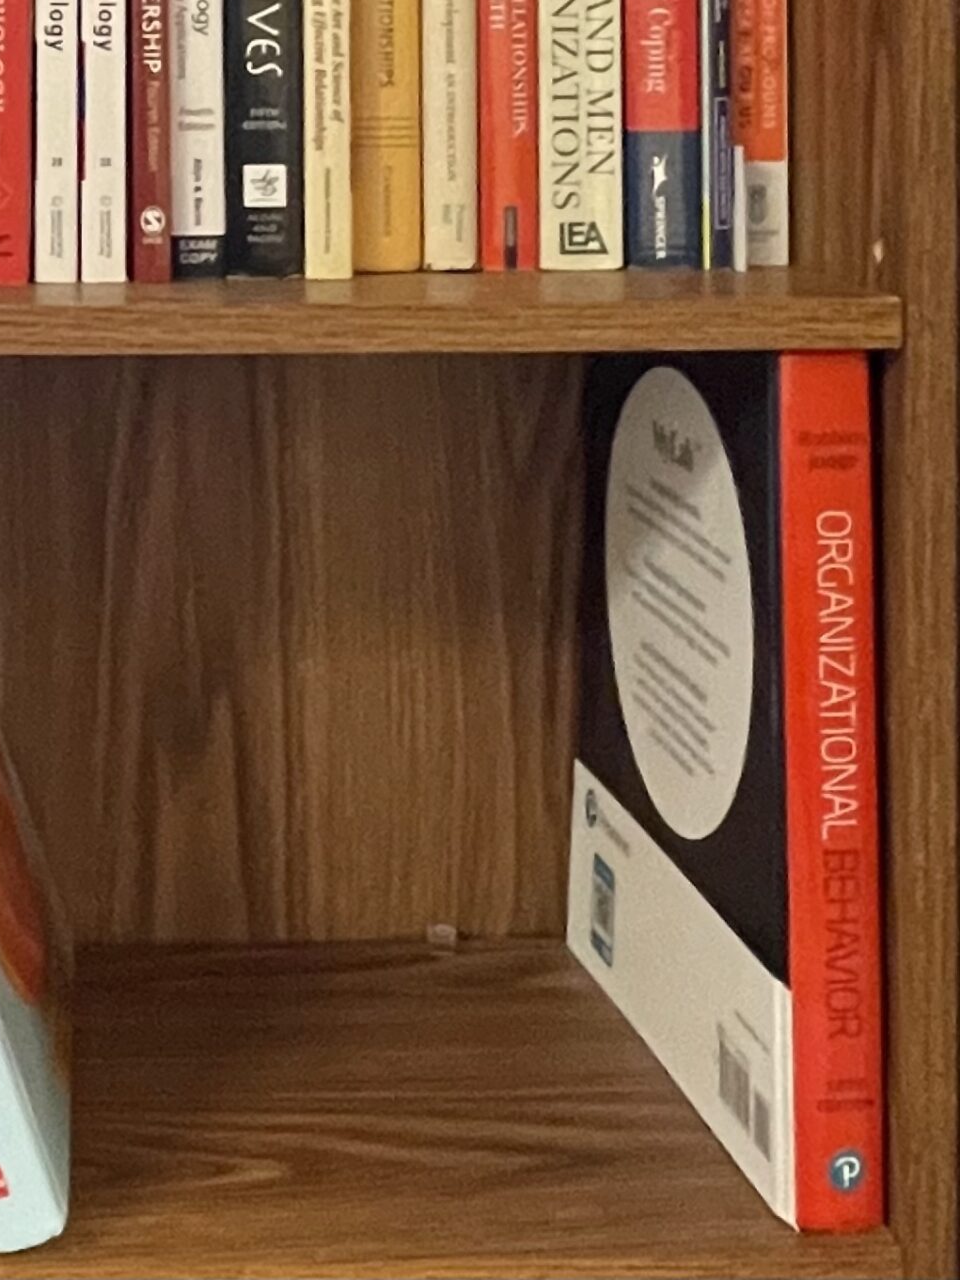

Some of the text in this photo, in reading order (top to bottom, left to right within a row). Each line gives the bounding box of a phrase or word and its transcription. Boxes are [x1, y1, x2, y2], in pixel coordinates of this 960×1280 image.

[175, 5, 189, 79] Applications
[585, 89, 615, 176] MEN
[179, 252, 219, 265] COPY
[654, 195, 667, 260] SPRINGER
[815, 510, 861, 839] ORGANIZATIONAL
[821, 847, 862, 1041] BEHAVIOR
